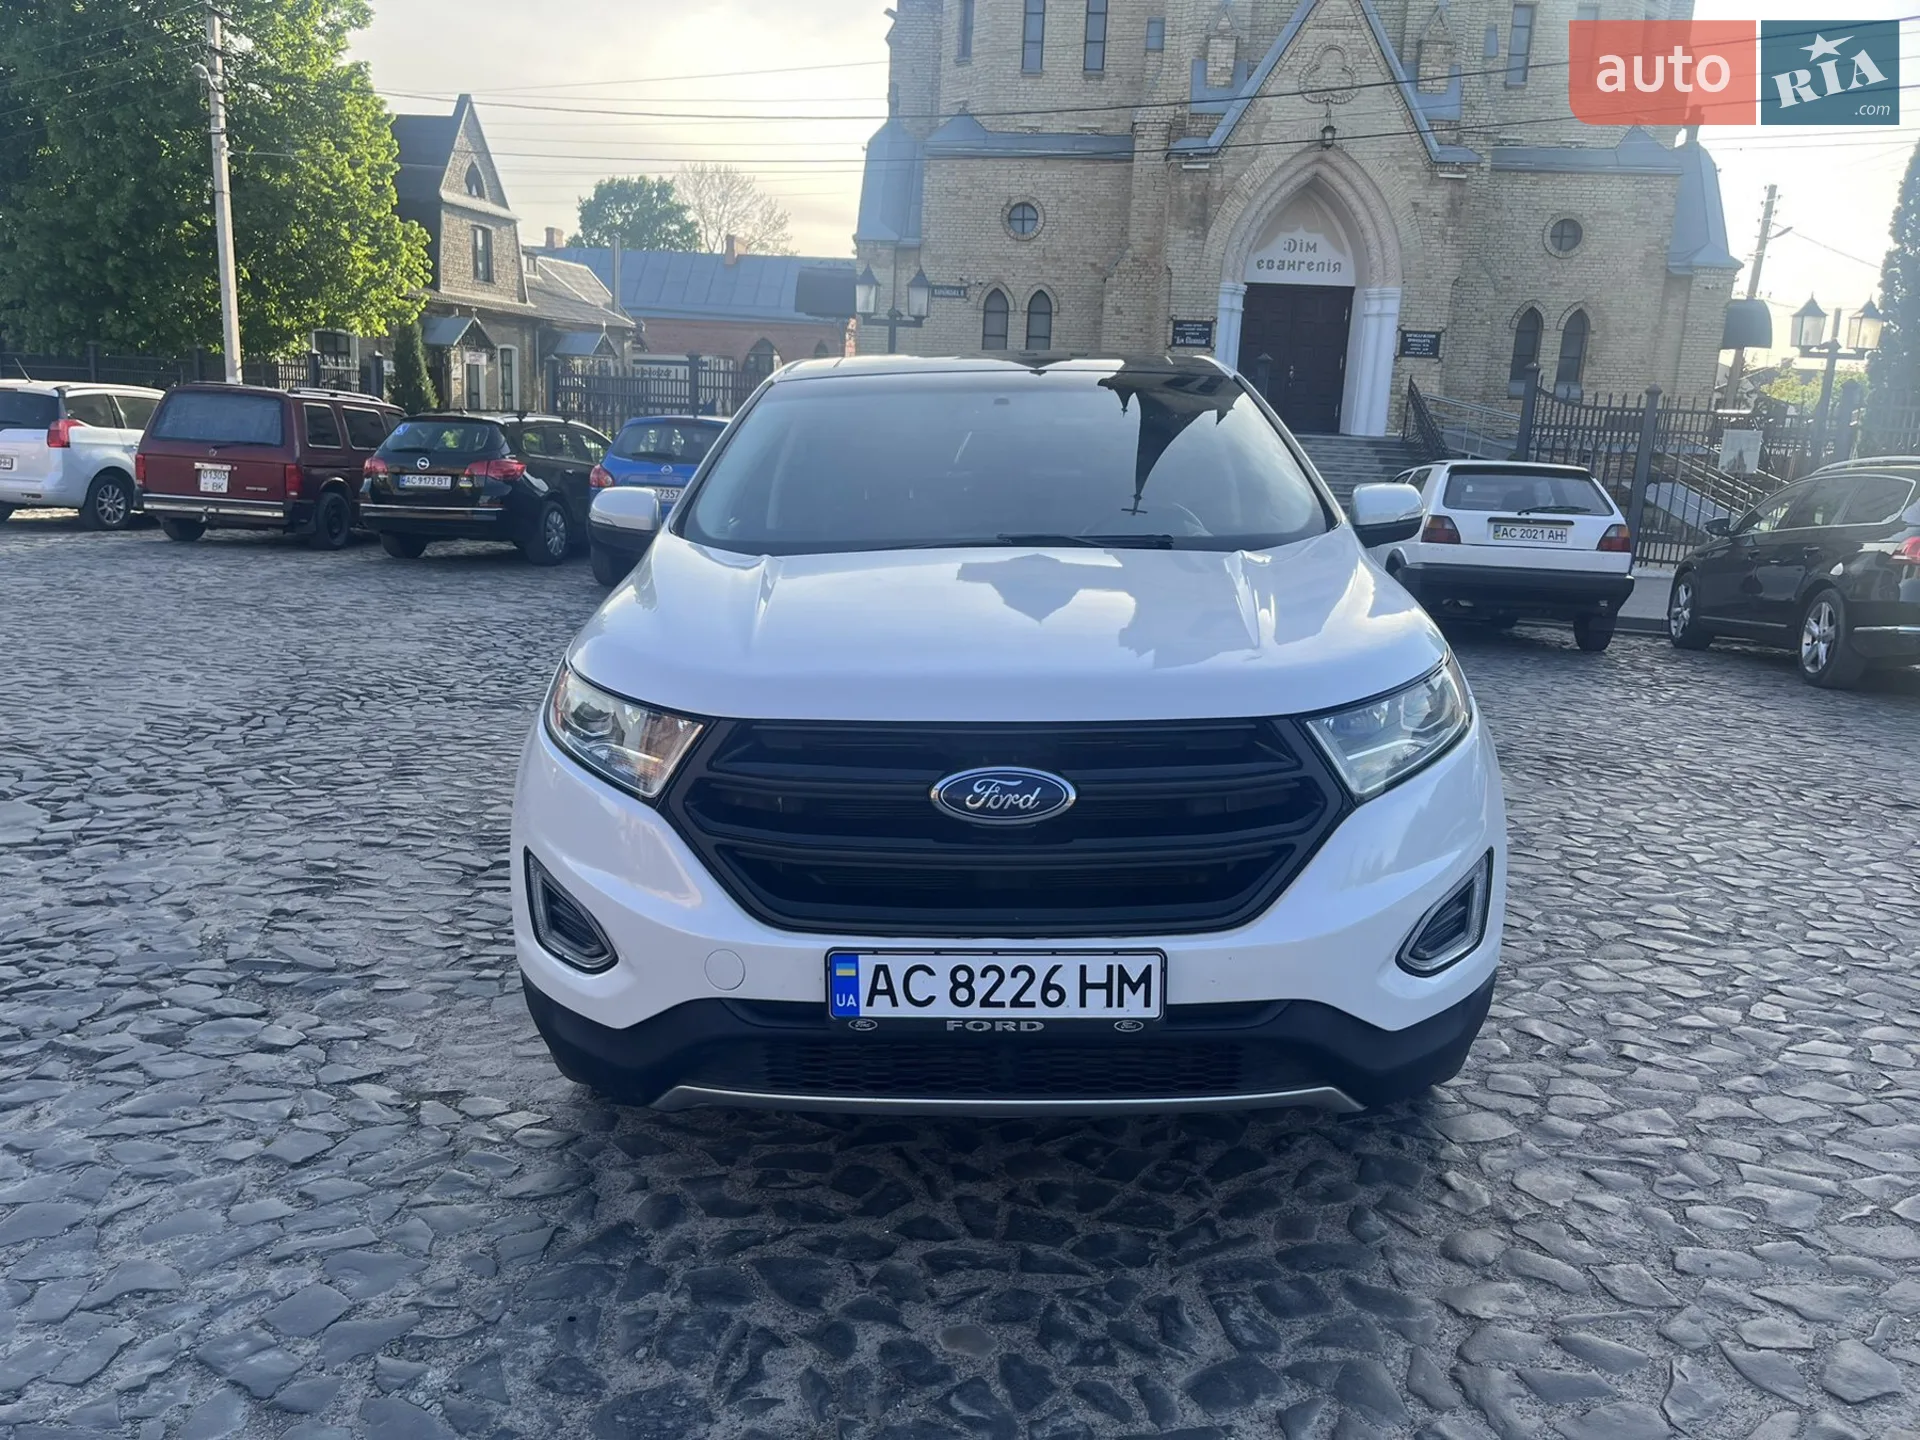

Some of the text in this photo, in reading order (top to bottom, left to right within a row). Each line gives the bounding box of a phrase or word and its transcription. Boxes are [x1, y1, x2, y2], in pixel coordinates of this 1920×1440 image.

[1283, 238, 1318, 253] Дім
[1501, 527, 1564, 541] AC 2021 AH
[965, 778, 1042, 810] Ford
[836, 964, 1152, 1008] UA AC 8226 HM
[946, 1020, 1045, 1032] FORD
